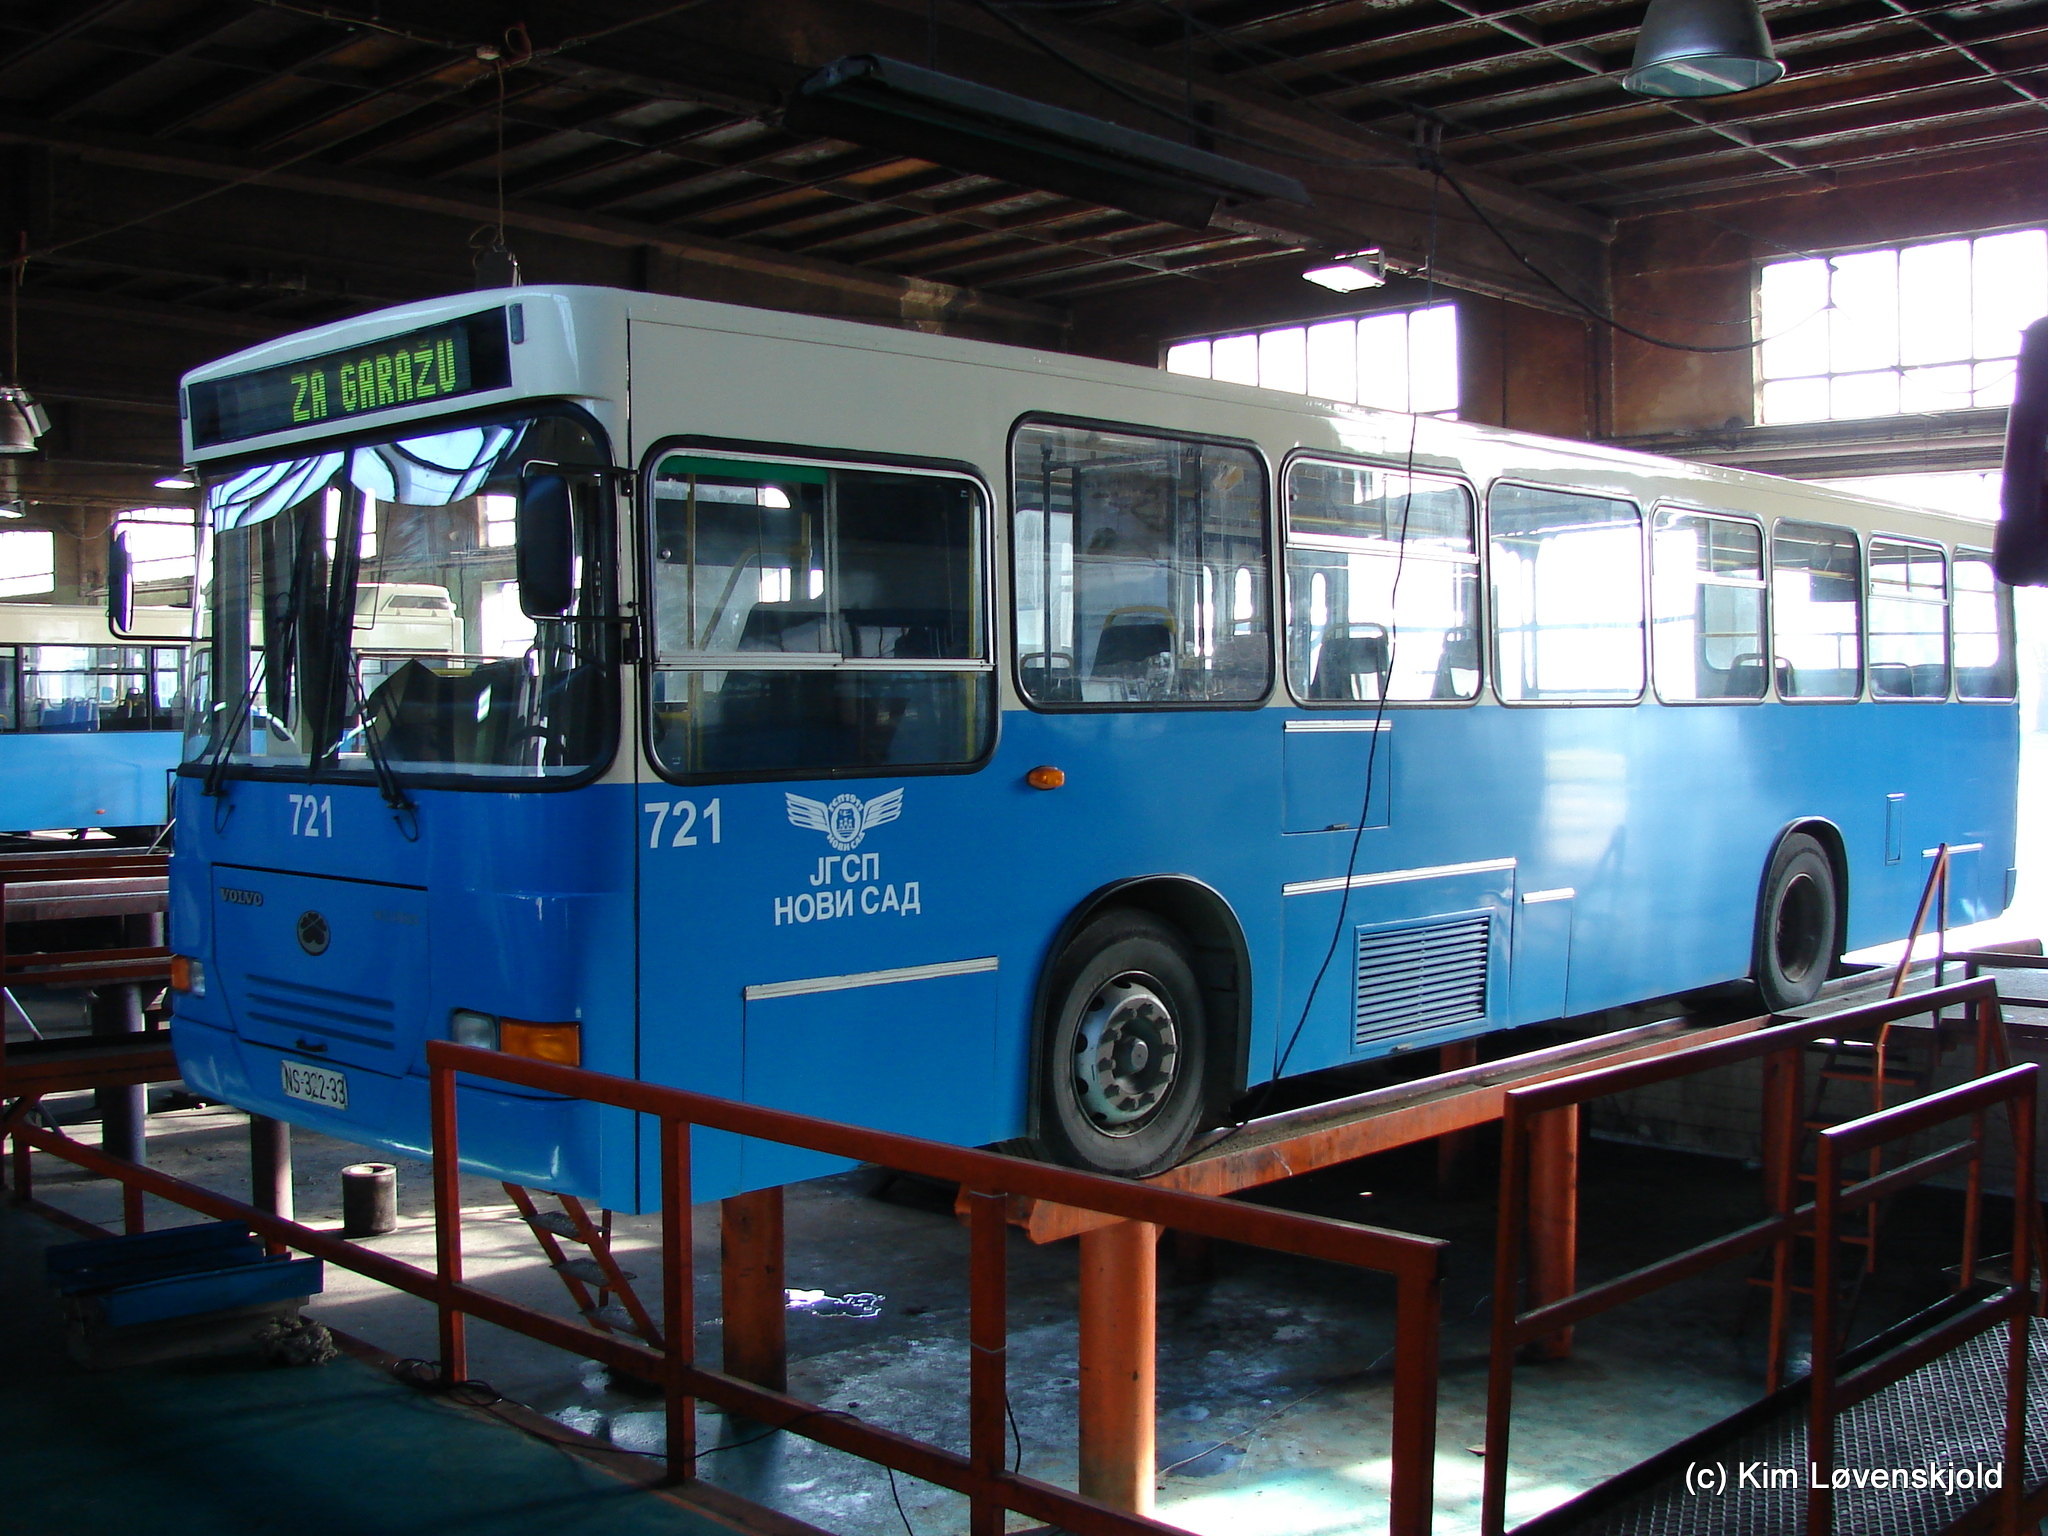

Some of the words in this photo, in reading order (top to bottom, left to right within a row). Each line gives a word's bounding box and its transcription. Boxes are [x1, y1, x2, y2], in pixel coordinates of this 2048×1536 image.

[290, 369, 328, 422] ZA
[340, 338, 456, 412] GARAŽU
[289, 794, 333, 838] 721
[644, 798, 721, 849] 721
[809, 852, 879, 886] ЈГСП
[219, 887, 264, 907] VOLVO
[774, 889, 854, 926] НОВИ
[860, 881, 921, 916] САД
